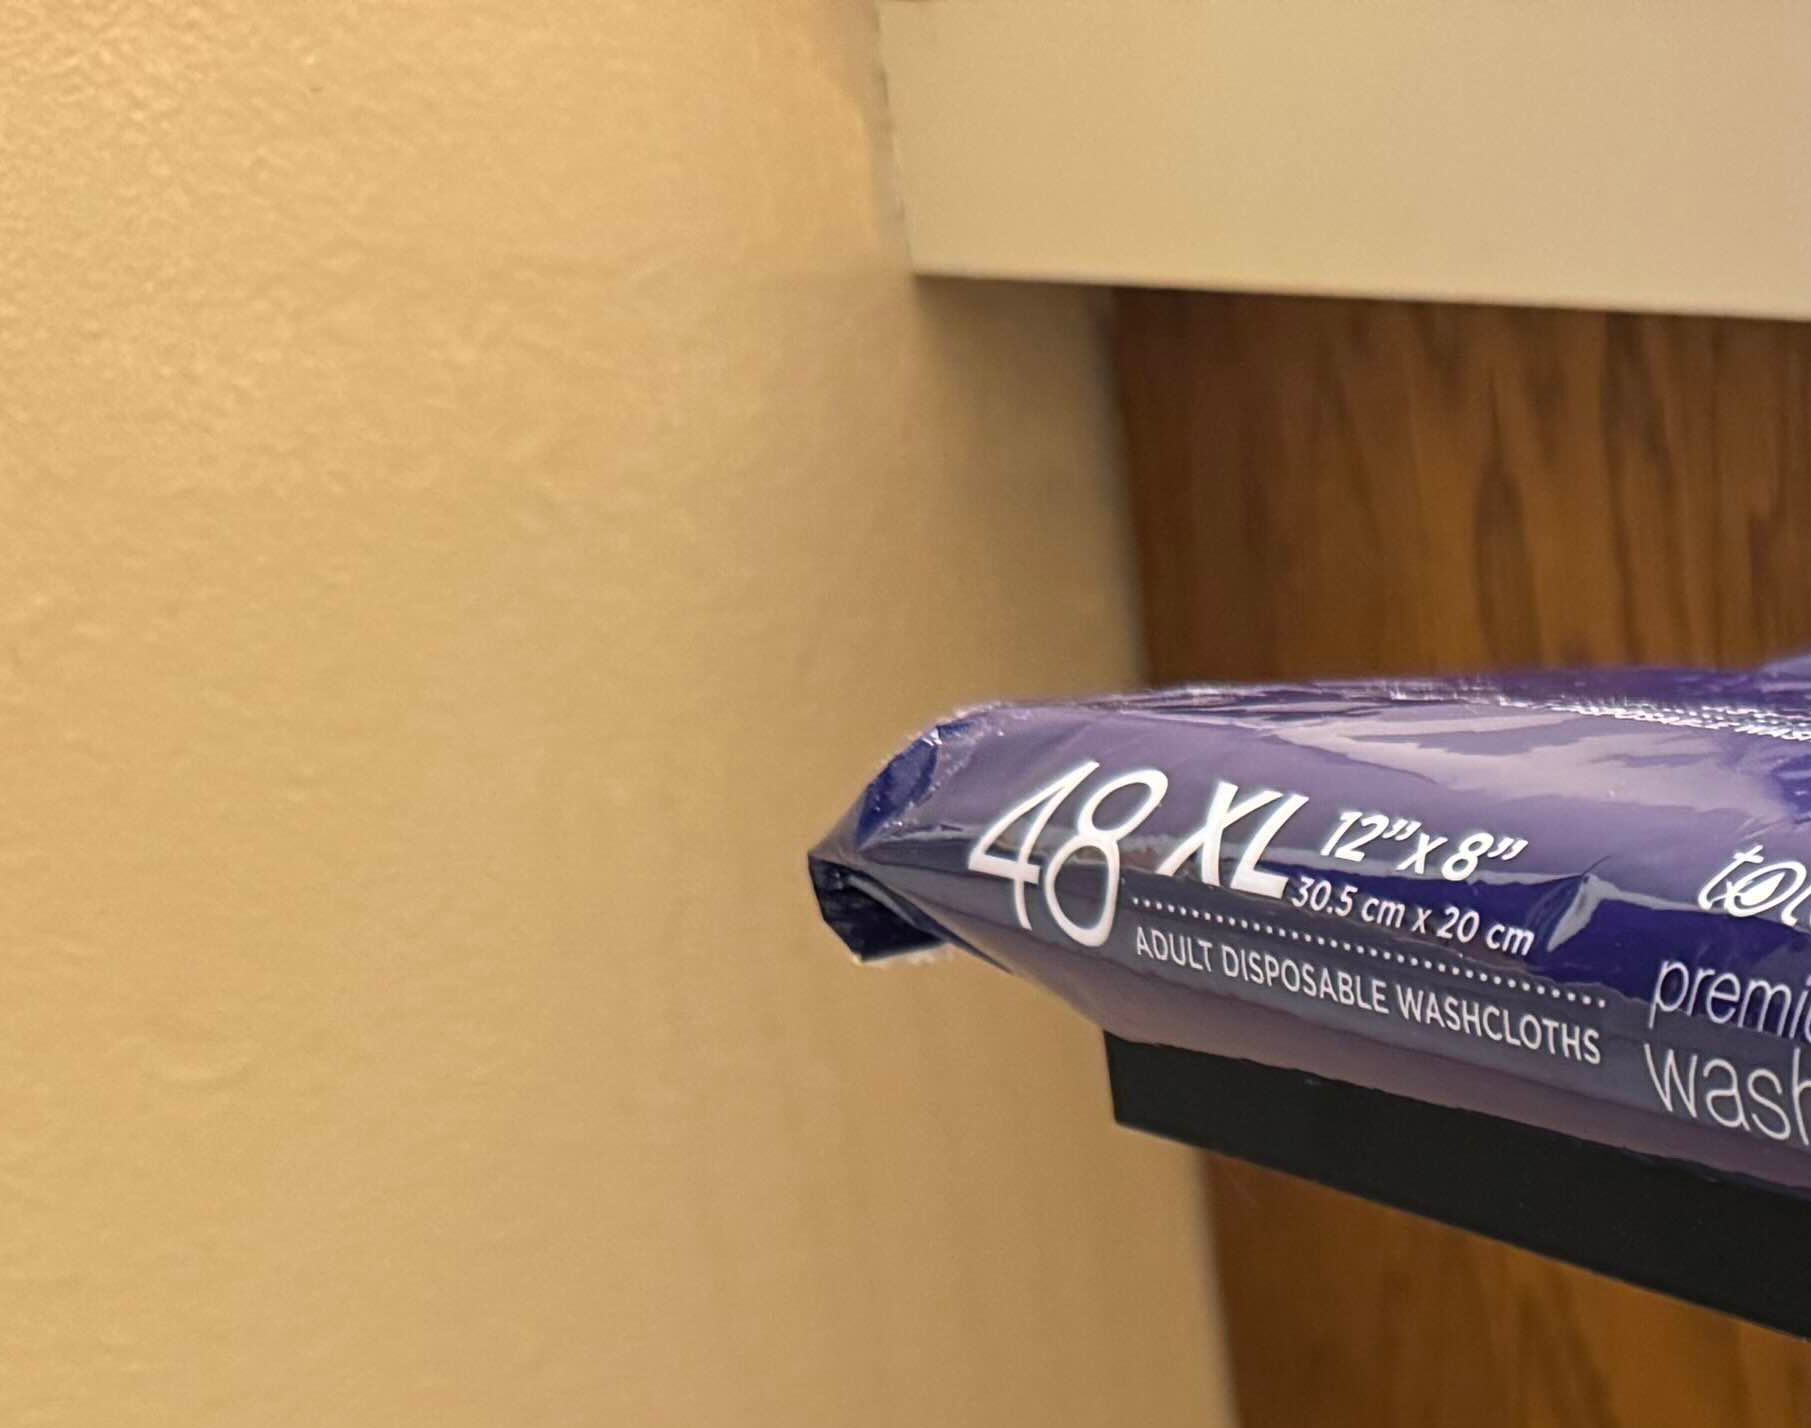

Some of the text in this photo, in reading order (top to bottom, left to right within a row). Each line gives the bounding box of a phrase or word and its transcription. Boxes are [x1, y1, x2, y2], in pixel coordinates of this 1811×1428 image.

[967, 760, 1169, 947] 48
[1155, 779, 1310, 900] XL
[1291, 876, 1536, 957] 30.5 cm x 20 cm
[1135, 926, 1602, 1065] ADULT DISPOSABLE WASHCLOTHS
